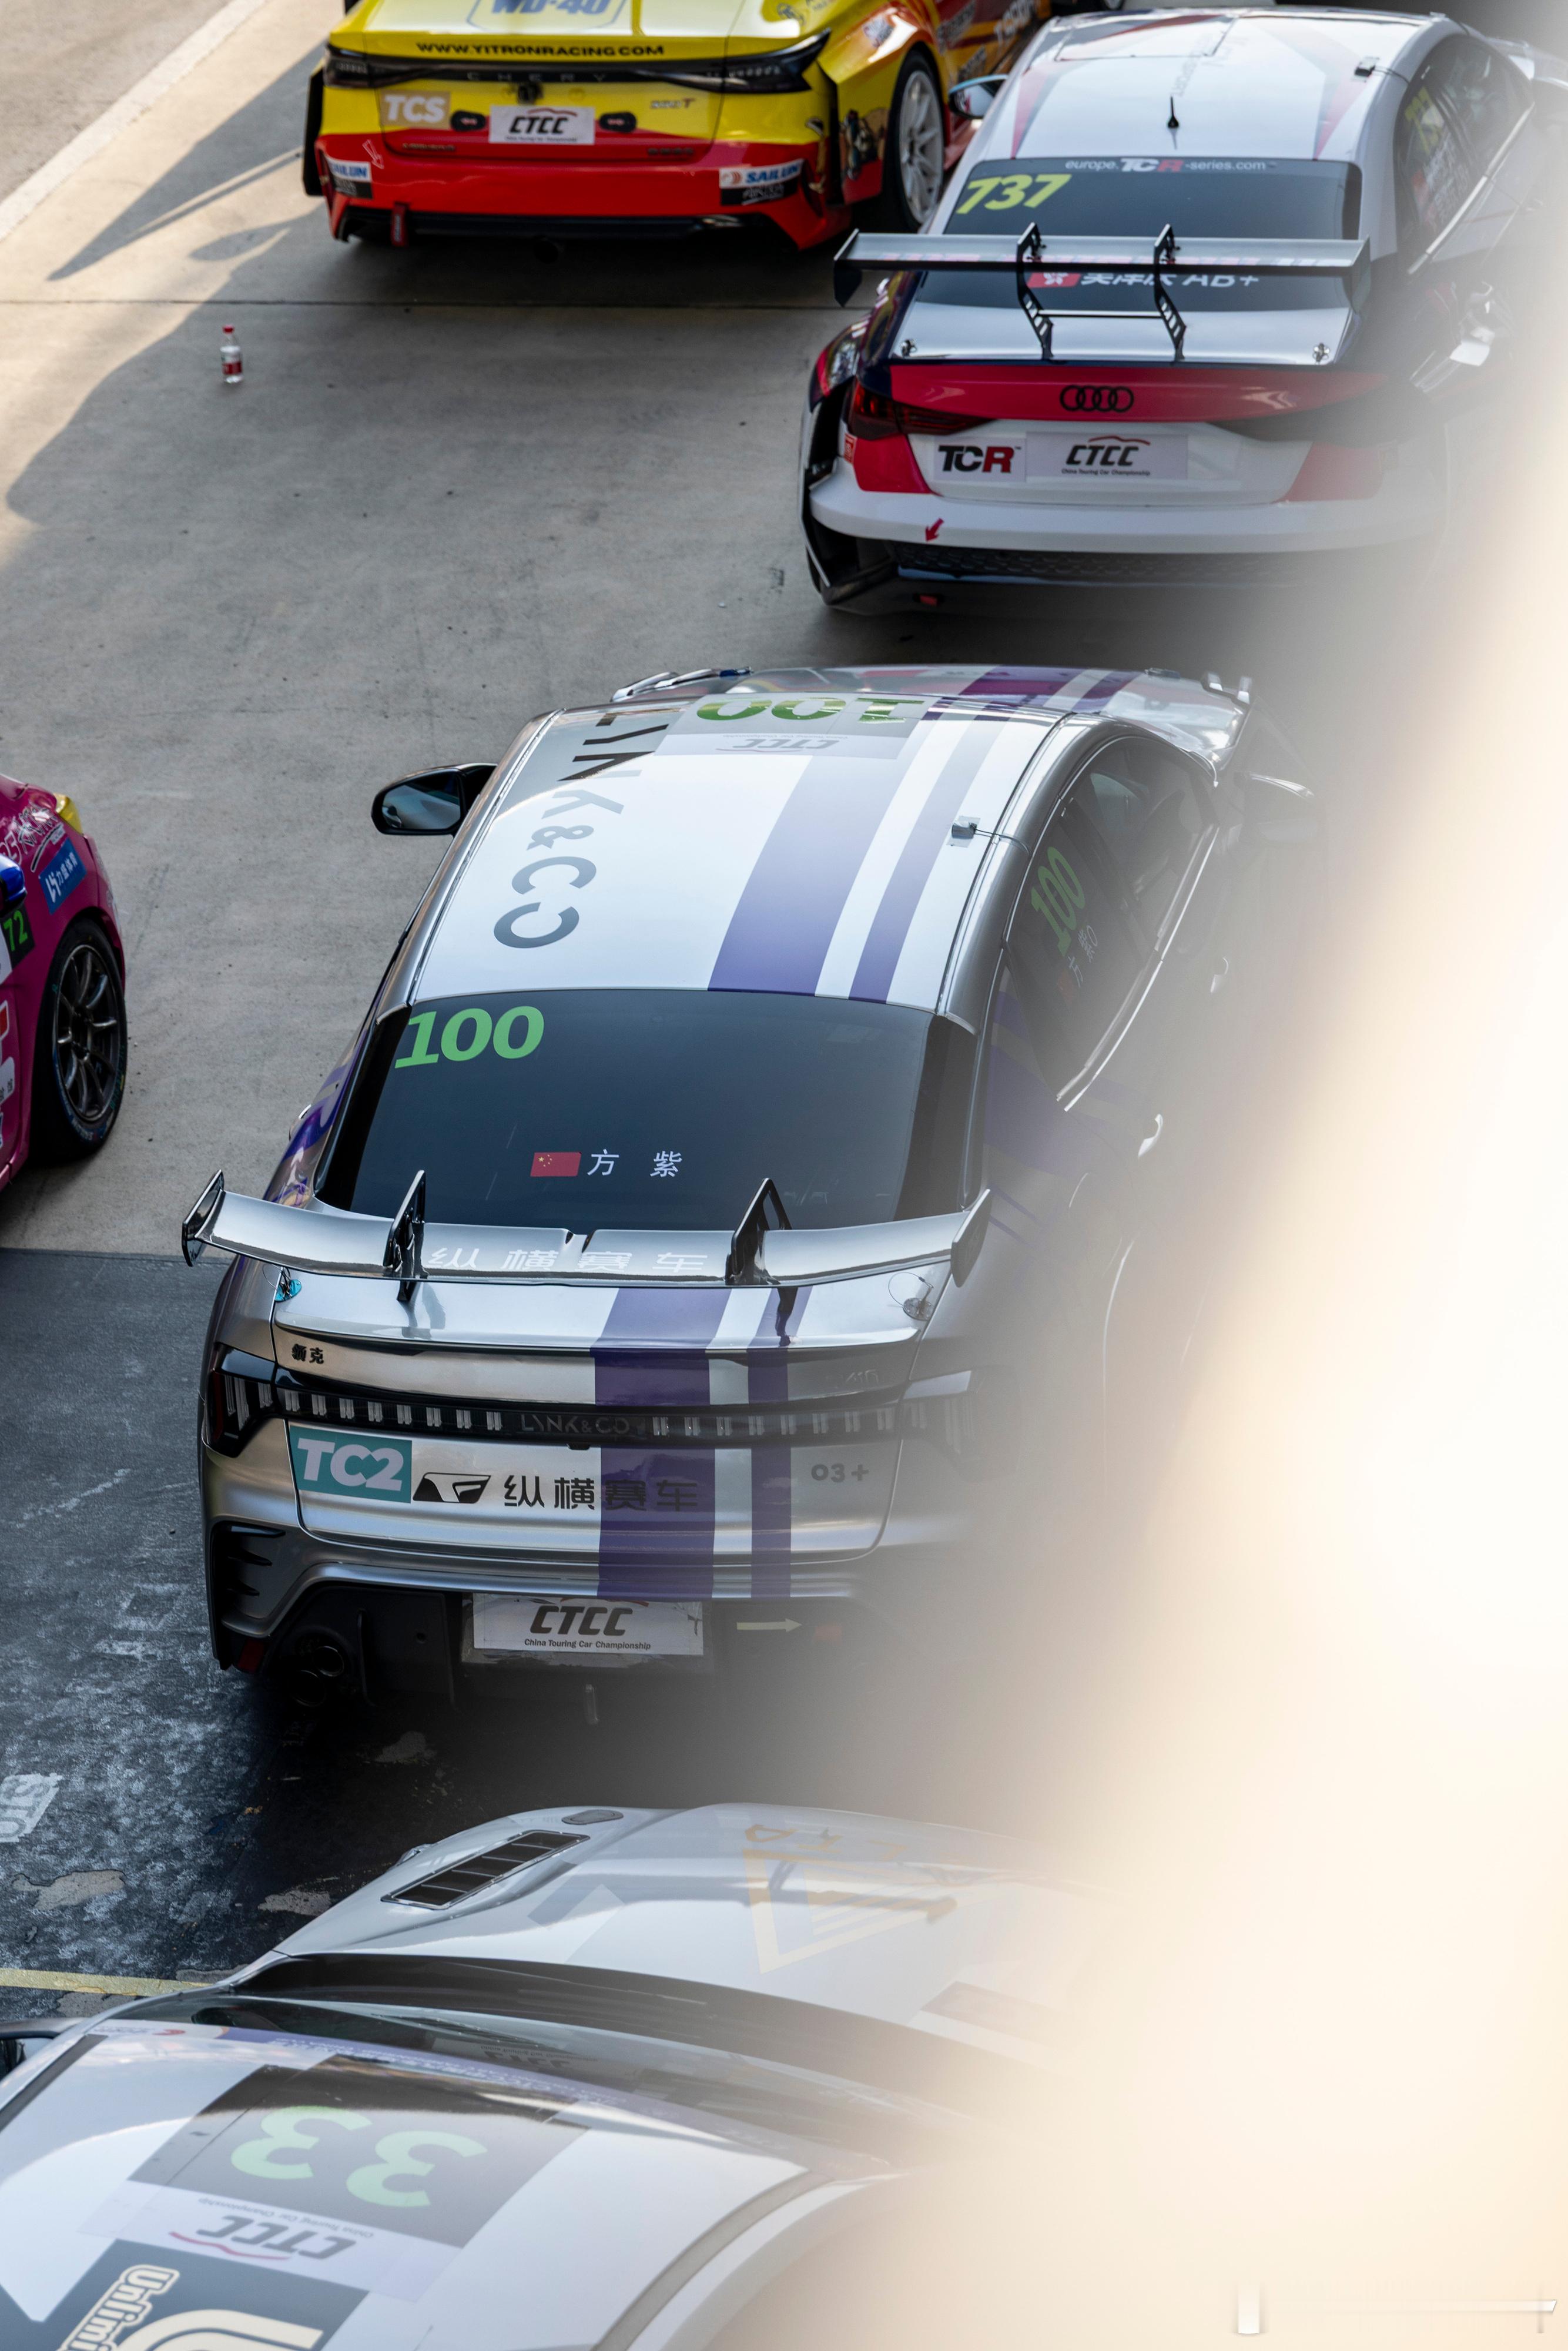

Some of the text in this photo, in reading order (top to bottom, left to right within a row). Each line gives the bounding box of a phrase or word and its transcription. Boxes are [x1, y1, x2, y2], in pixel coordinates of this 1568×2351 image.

[384, 93, 447, 123] TCS
[509, 116, 569, 135] CTCC
[331, 164, 367, 178] AILUN
[956, 174, 1072, 215] 737
[938, 445, 1015, 473] TCR
[1066, 445, 1139, 466] CTCC
[697, 697, 926, 724] 100
[732, 739, 840, 749] CTCC
[1031, 846, 1086, 957] 100
[395, 1006, 544, 1069] 100
[588, 1148, 682, 1177] 方 紫
[425, 1247, 708, 1274] 纵横赛车
[297, 1437, 404, 1492] TC2
[504, 1474, 699, 1512] 纵横赛车
[530, 1605, 633, 1636] CTCC
[524, 1639, 547, 1647] China
[548, 1639, 577, 1649] Touring
[595, 1641, 651, 1650] Championship
[230, 2104, 488, 2208] 33
[196, 2215, 357, 2260] CTCC
